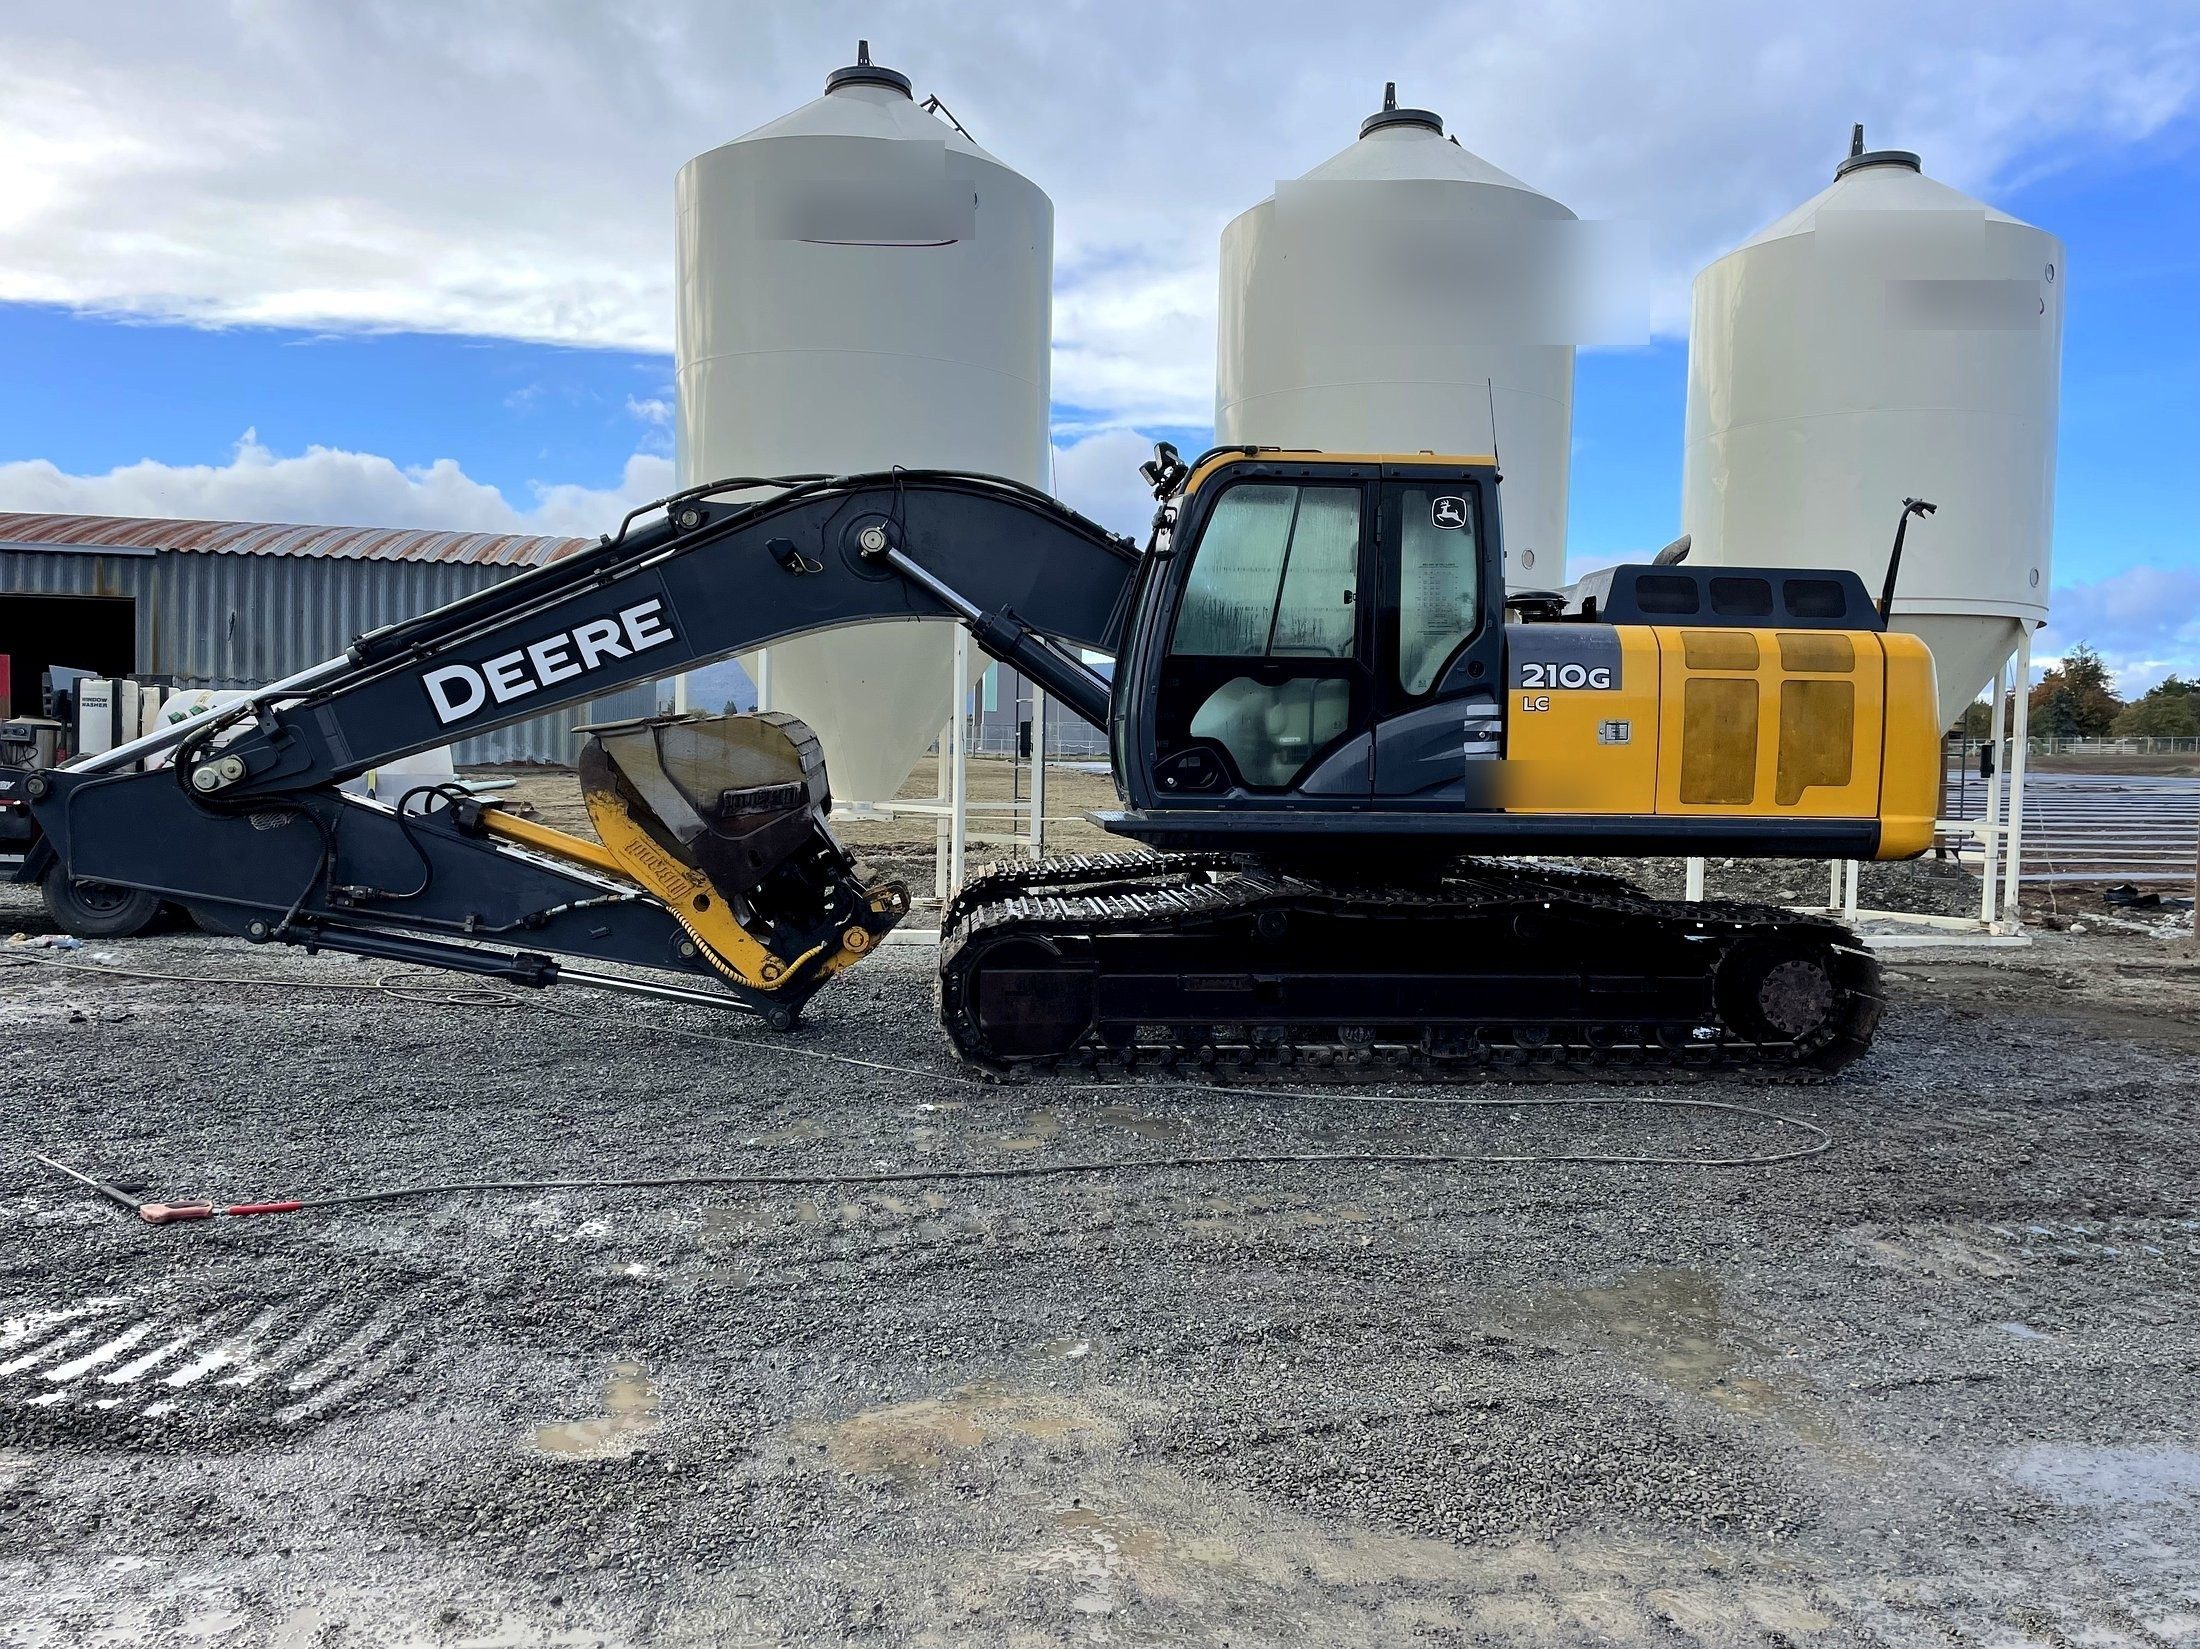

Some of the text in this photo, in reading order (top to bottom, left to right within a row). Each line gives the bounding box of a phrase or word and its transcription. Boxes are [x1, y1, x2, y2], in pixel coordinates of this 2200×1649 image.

[422, 598, 674, 724] DEERE
[1521, 663, 1611, 689] 210G
[1522, 696, 1550, 711] LC
